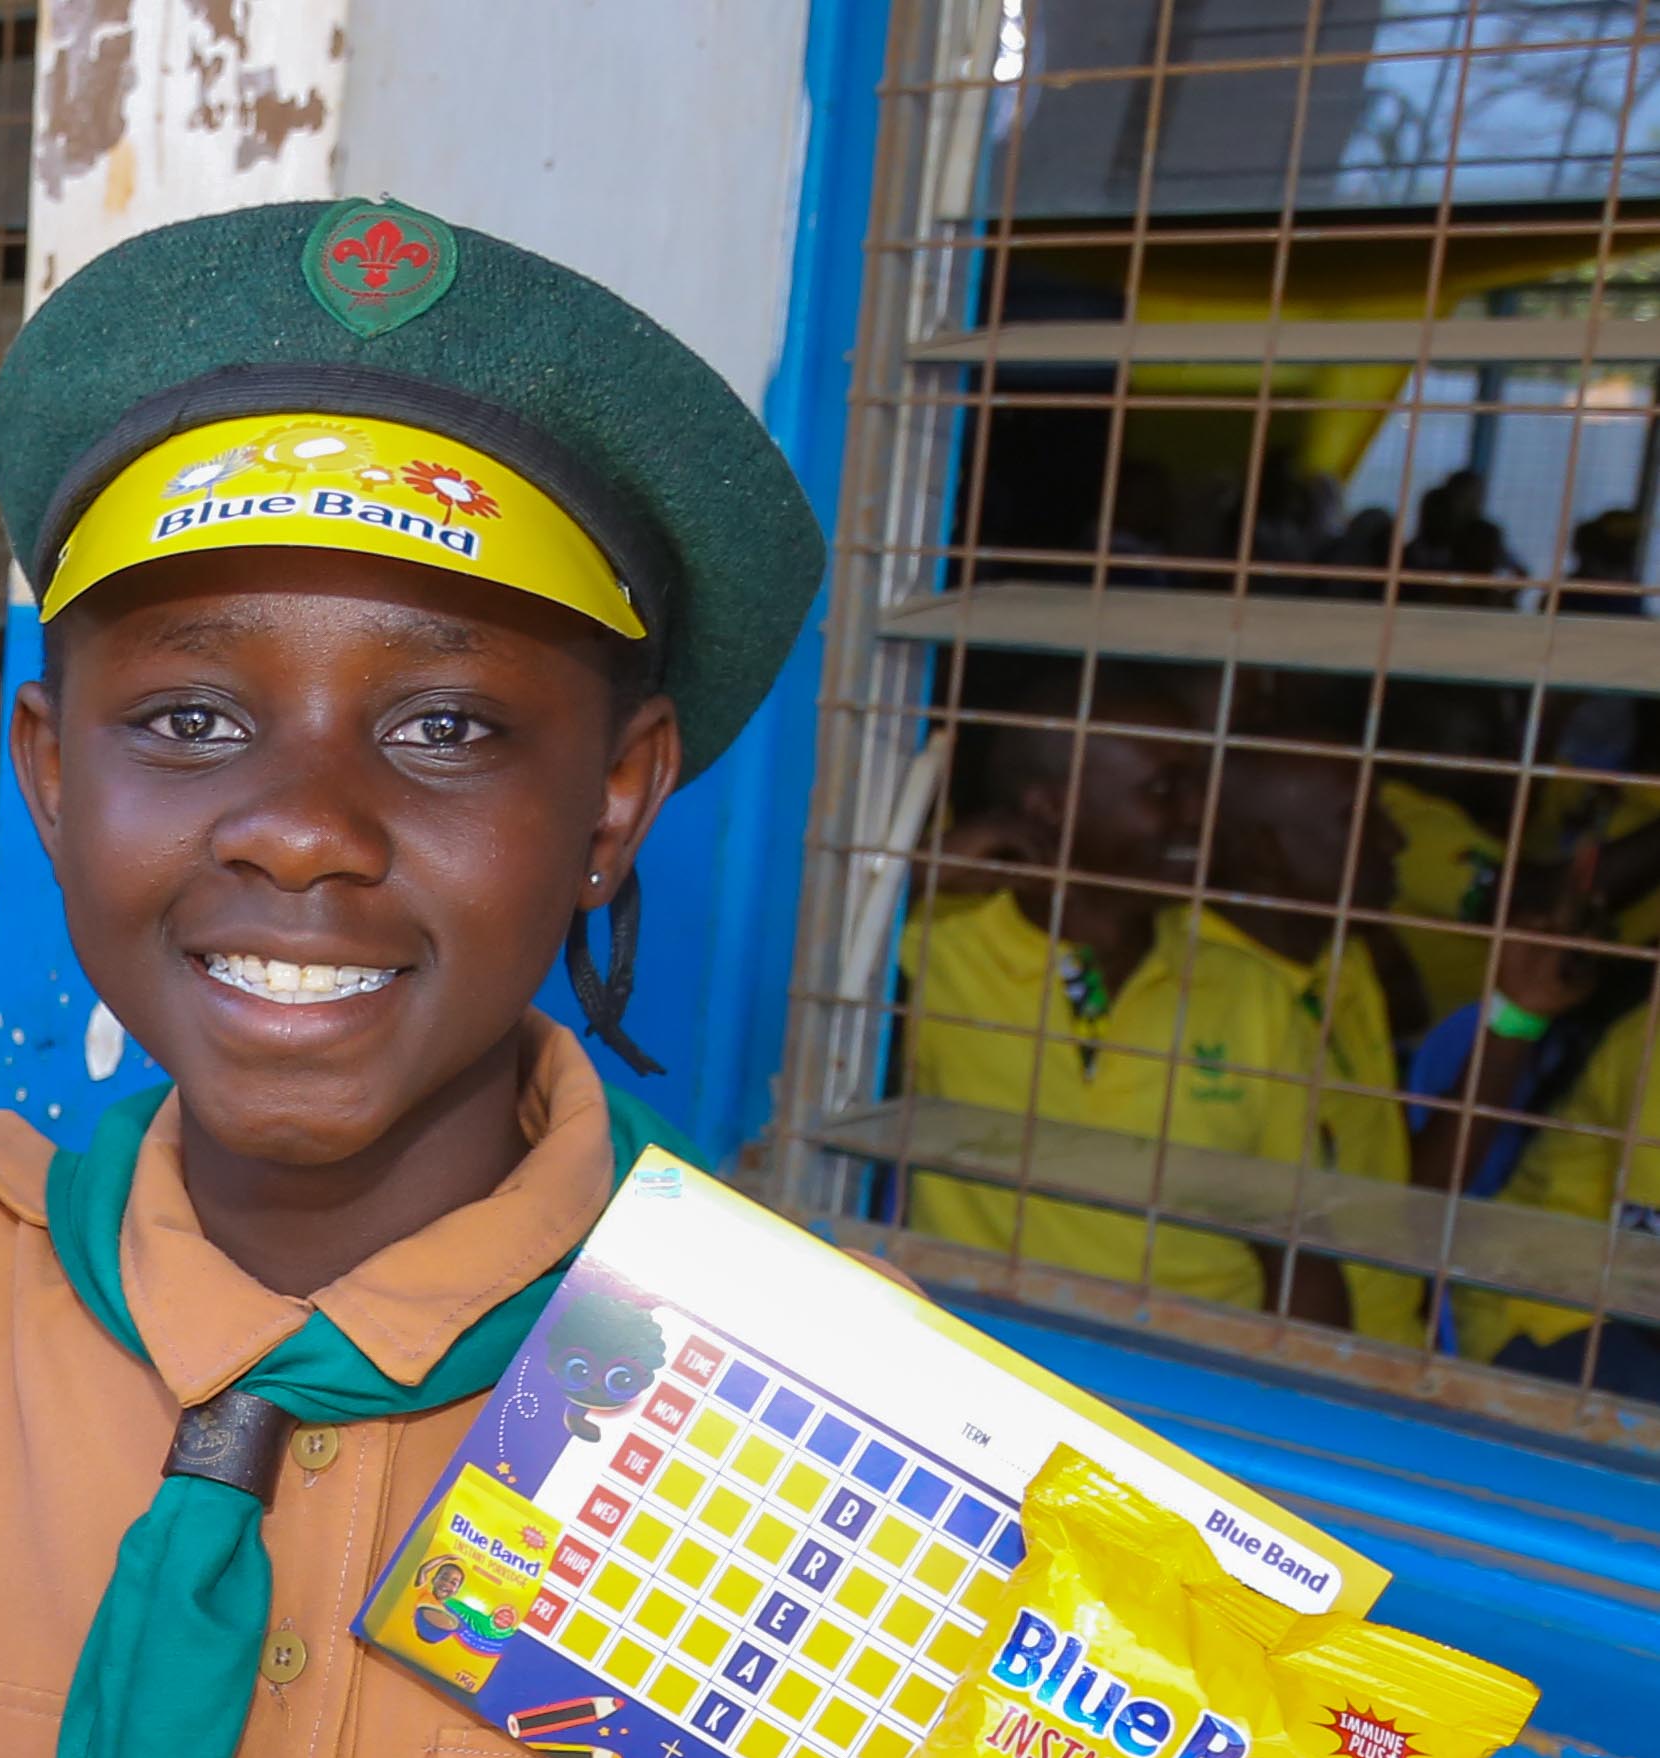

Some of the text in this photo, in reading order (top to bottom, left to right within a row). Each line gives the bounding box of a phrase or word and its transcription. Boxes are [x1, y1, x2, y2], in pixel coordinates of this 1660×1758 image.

[157, 491, 477, 557] Blue Band
[683, 1348, 715, 1379] TIME
[651, 1398, 684, 1428] MON
[961, 1421, 992, 1448] TERM
[623, 1448, 652, 1476] TUE
[590, 1498, 620, 1525] WED
[450, 1514, 489, 1549] Blue
[490, 1539, 541, 1578] Band
[557, 1546, 592, 1576] THUR
[1205, 1508, 1329, 1594] Blue Band
[531, 1597, 558, 1622] FRI
[992, 1610, 1172, 1758] Blue
[1339, 1712, 1405, 1755] IMMUNE
